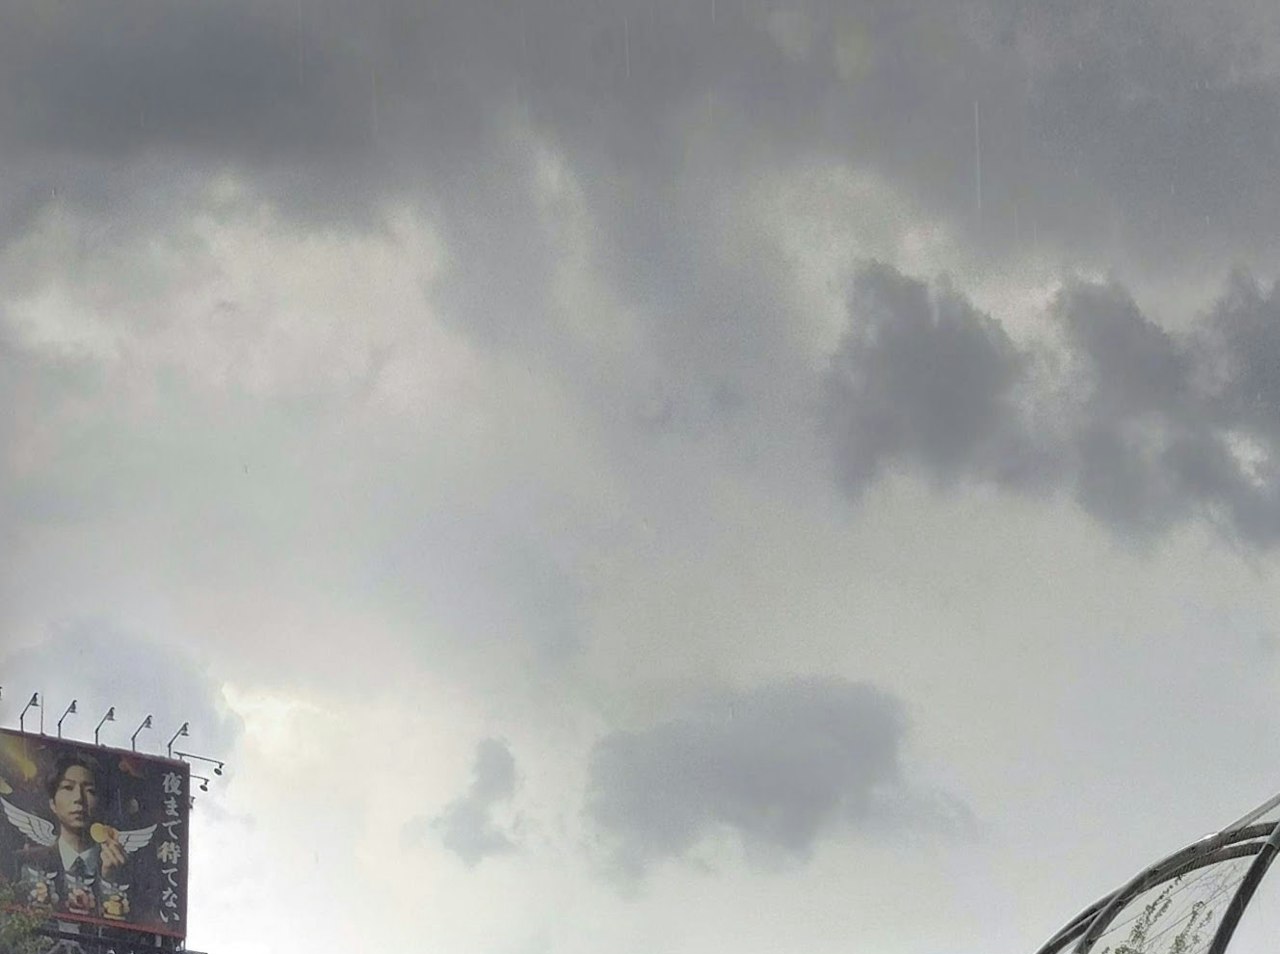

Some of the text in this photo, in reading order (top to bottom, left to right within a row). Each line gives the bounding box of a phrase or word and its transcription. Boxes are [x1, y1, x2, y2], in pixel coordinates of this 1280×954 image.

[156, 772, 183, 923] 夜まで待てない
